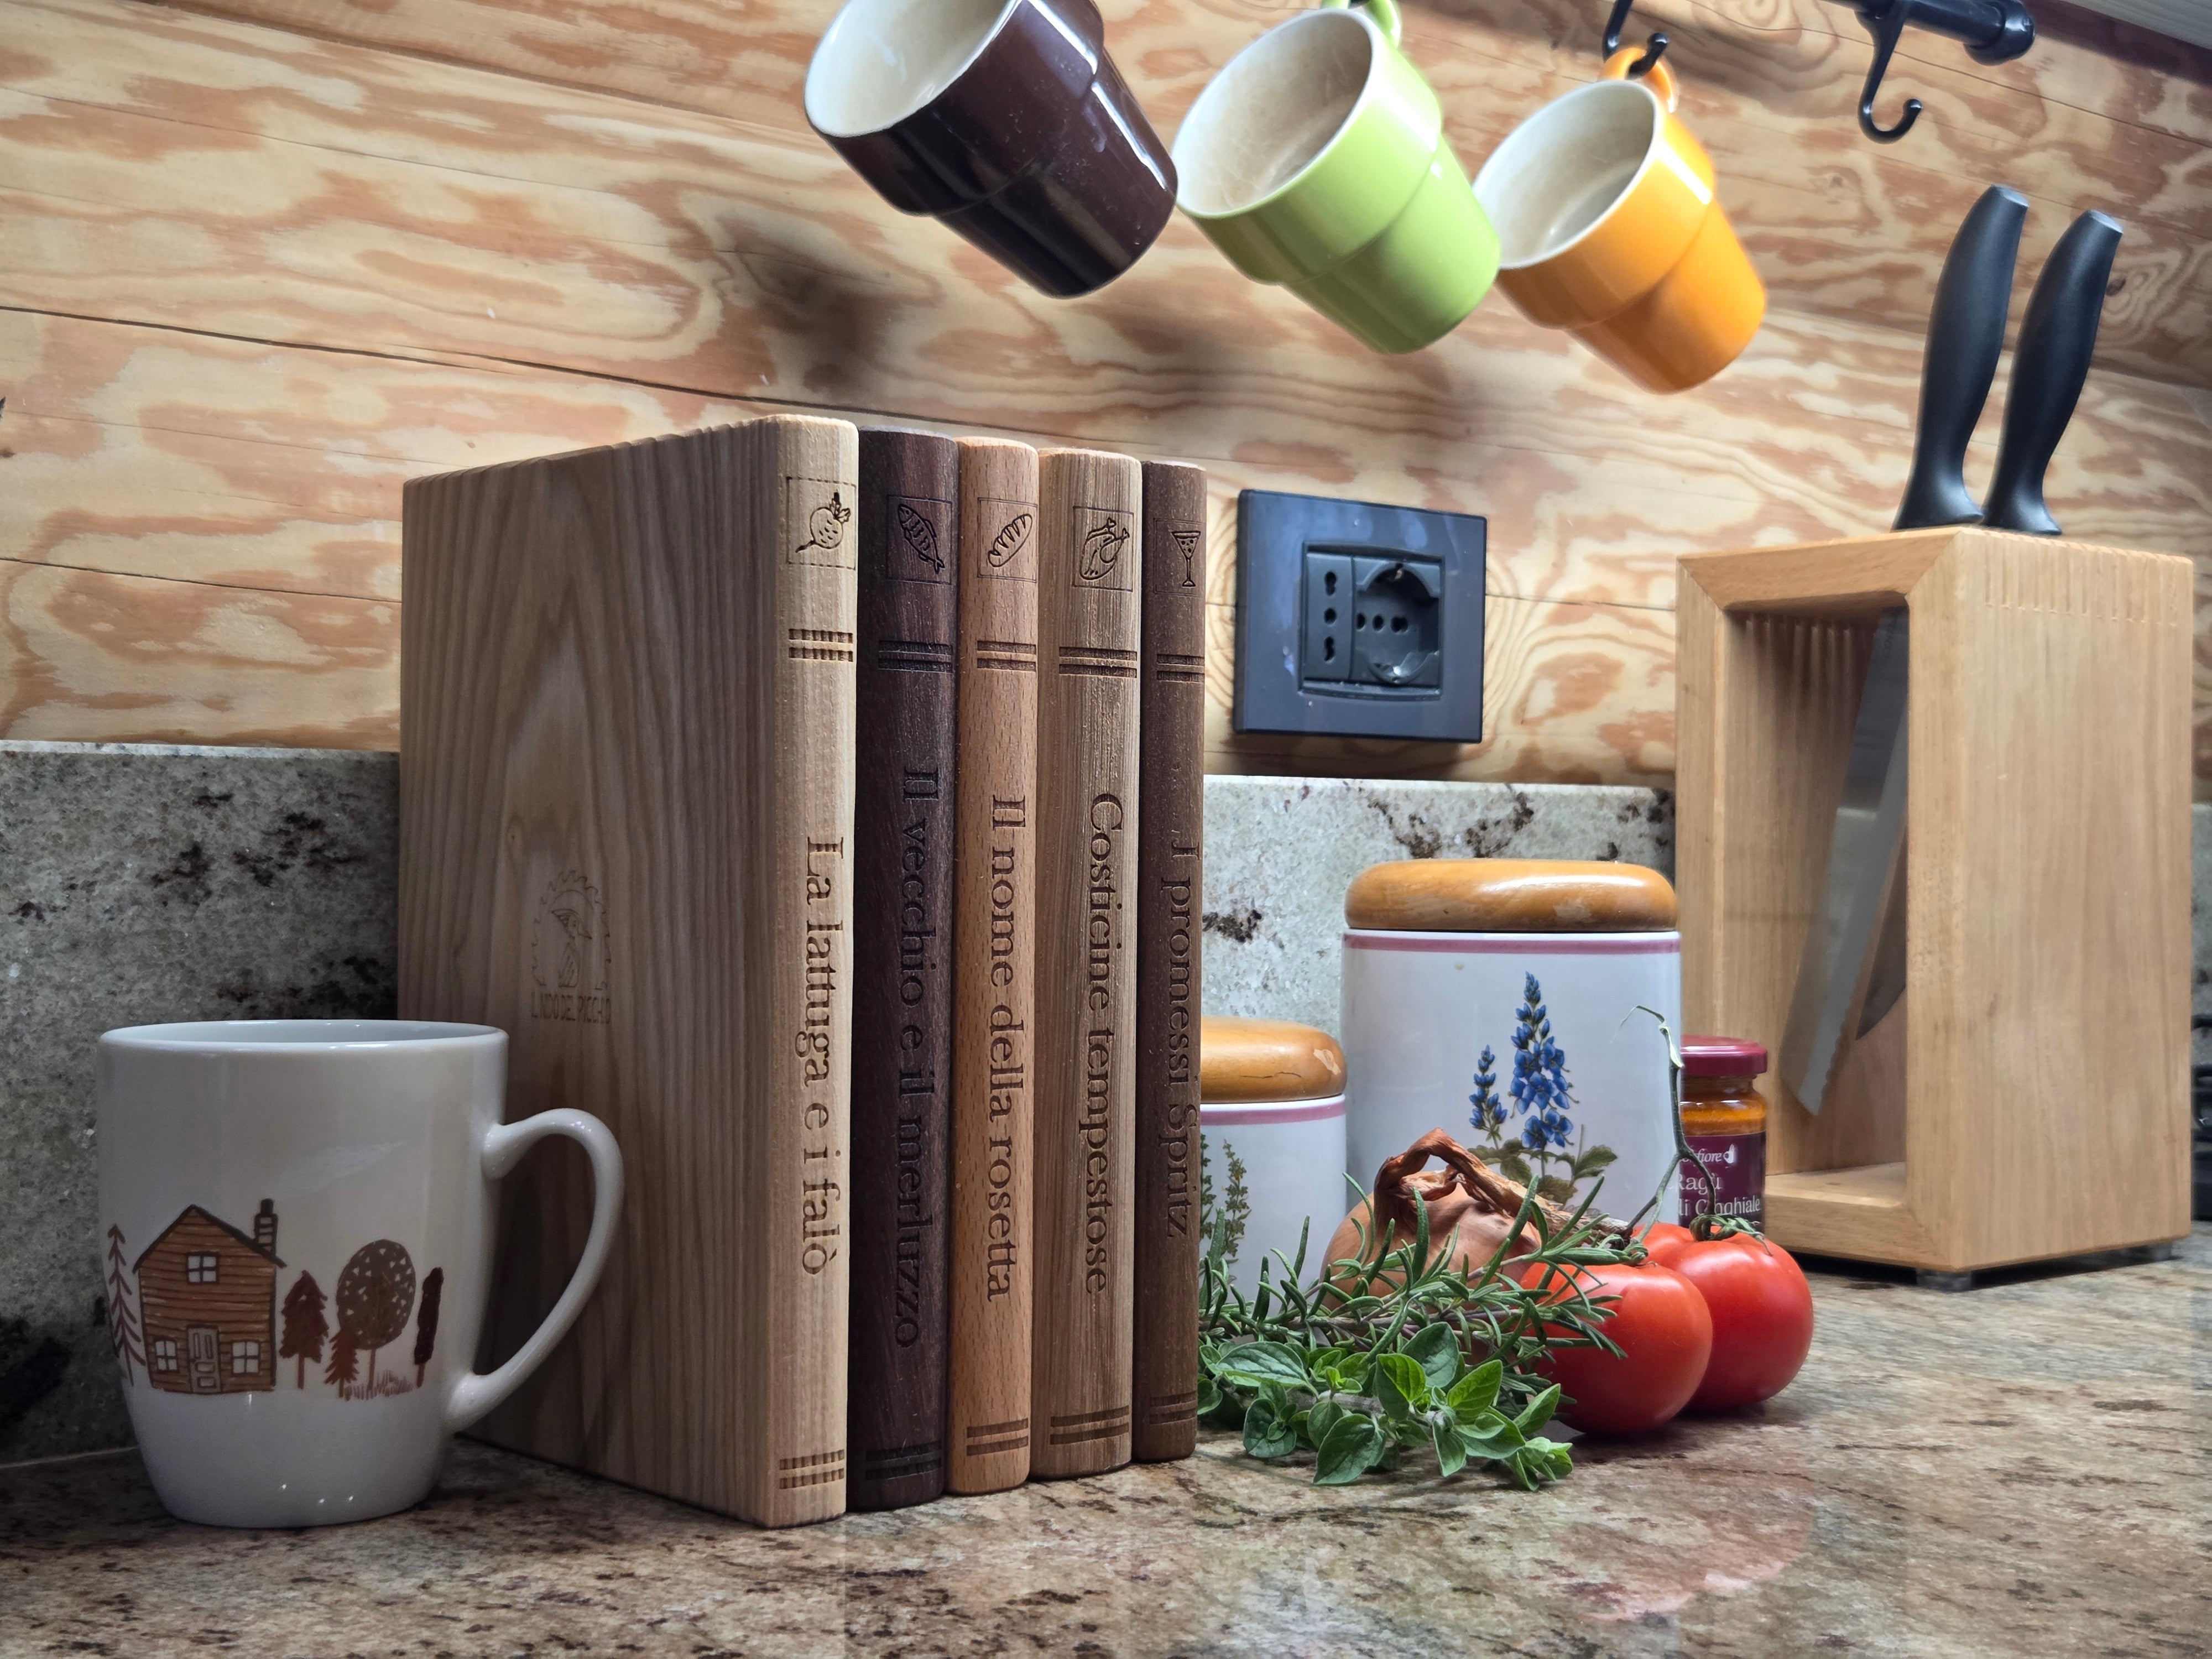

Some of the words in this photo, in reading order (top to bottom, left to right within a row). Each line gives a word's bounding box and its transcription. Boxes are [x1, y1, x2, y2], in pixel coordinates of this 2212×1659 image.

[902, 766, 938, 802] Il
[992, 794, 1026, 831] Il
[807, 837, 843, 904] La
[1089, 793, 1123, 1011] Costicine
[1171, 842, 1200, 860] I
[900, 818, 936, 1007] vecchio
[990, 847, 1014, 987] nome
[795, 920, 843, 1087] lattuga
[900, 1025, 923, 1051] e
[1161, 877, 1198, 1088] promessi
[804, 1102, 829, 1131] e
[899, 1068, 935, 1097] il
[989, 1004, 1024, 1123] della
[804, 1147, 841, 1164] i
[1078, 1027, 1114, 1294] tempestose
[1159, 1104, 1197, 1238] Spritz
[802, 1178, 841, 1275] falò
[895, 1115, 933, 1348] merluzzo
[987, 1135, 1016, 1302] rosetta
